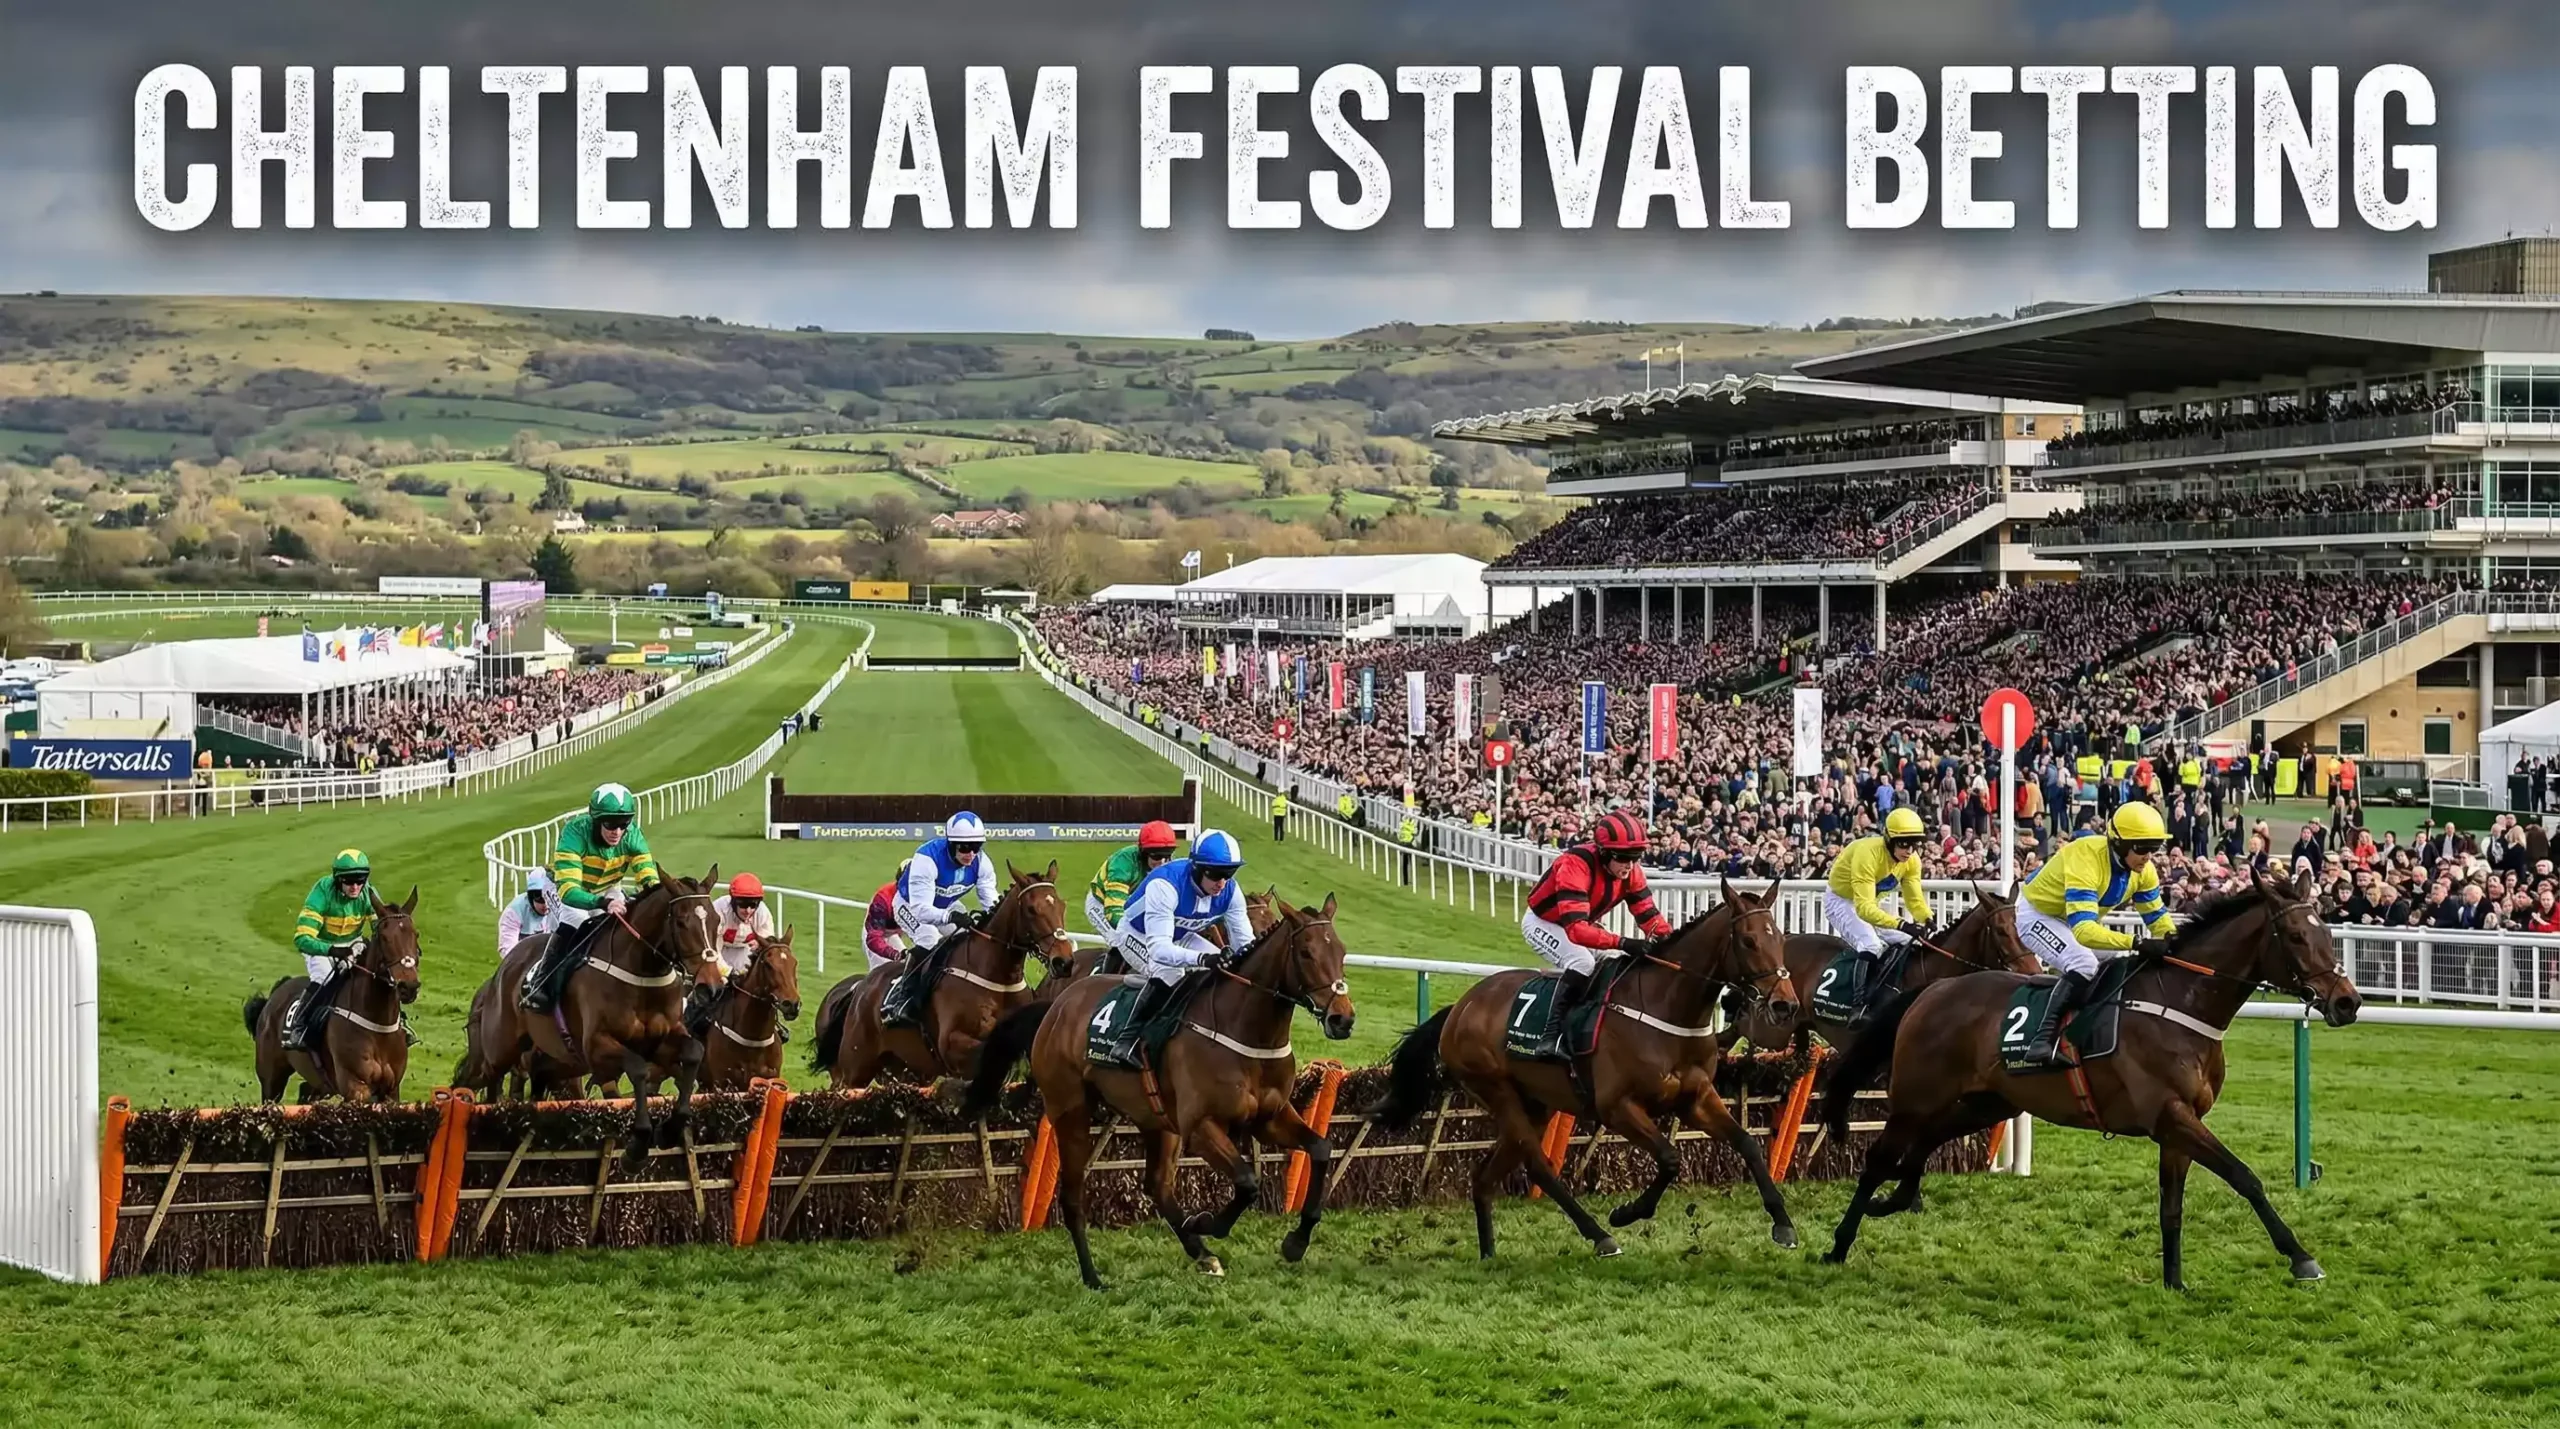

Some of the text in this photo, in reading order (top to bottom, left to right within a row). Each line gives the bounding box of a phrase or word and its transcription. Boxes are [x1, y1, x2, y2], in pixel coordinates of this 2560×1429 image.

[31, 745, 173, 771] Tattersalls
[1493, 745, 1505, 762] 6
[1816, 968, 1838, 997] 2
[1091, 1000, 1117, 1034] 4
[1513, 992, 1537, 1028] 7
[2003, 1005, 2029, 1042] 2
